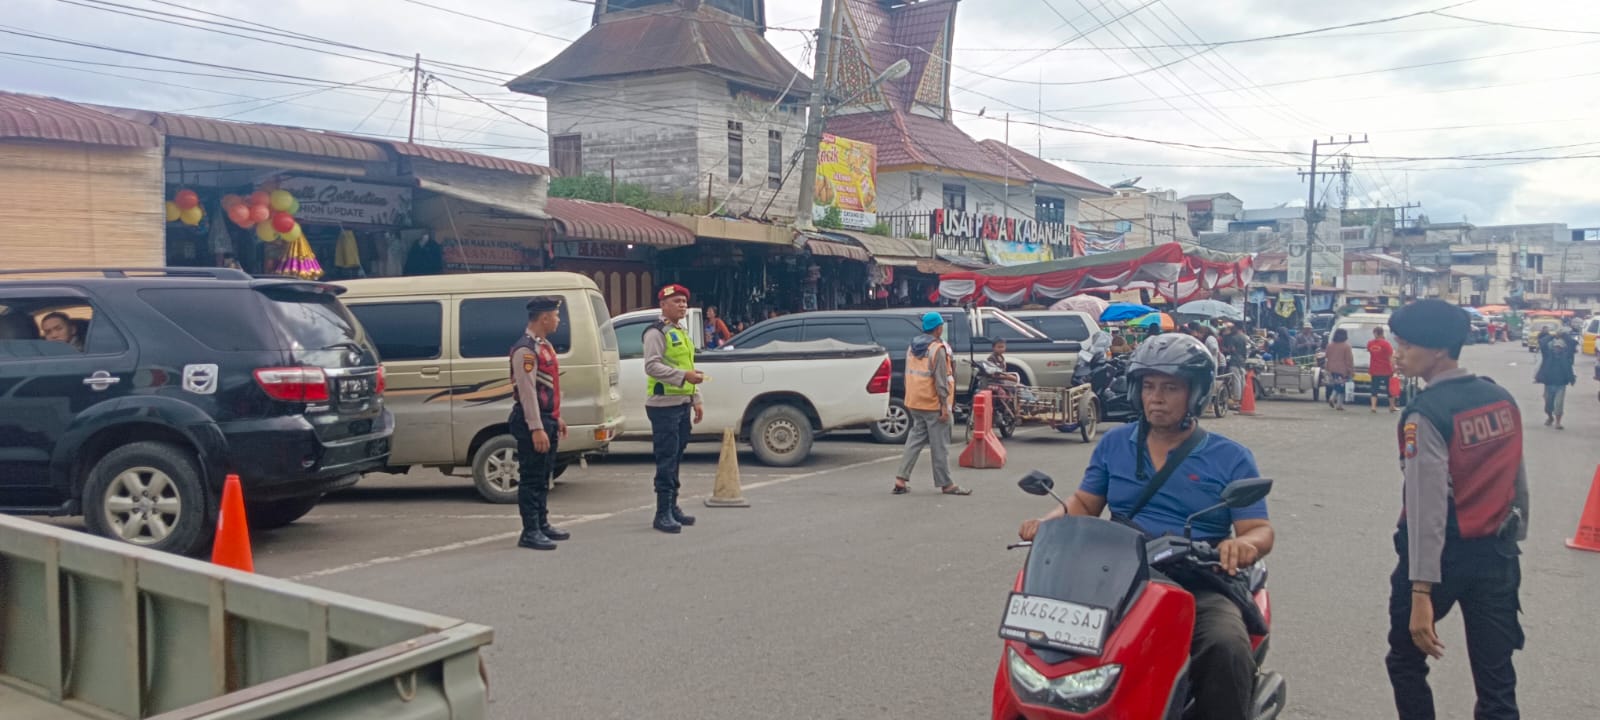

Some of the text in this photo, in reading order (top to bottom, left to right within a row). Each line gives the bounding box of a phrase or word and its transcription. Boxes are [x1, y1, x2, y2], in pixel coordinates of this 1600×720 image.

[319, 185, 388, 206] Collection
[327, 207, 366, 218] UPDATE
[975, 212, 1015, 242] PASAR
[1459, 407, 1515, 446] POLISI
[1071, 609, 1103, 630] SAJ
